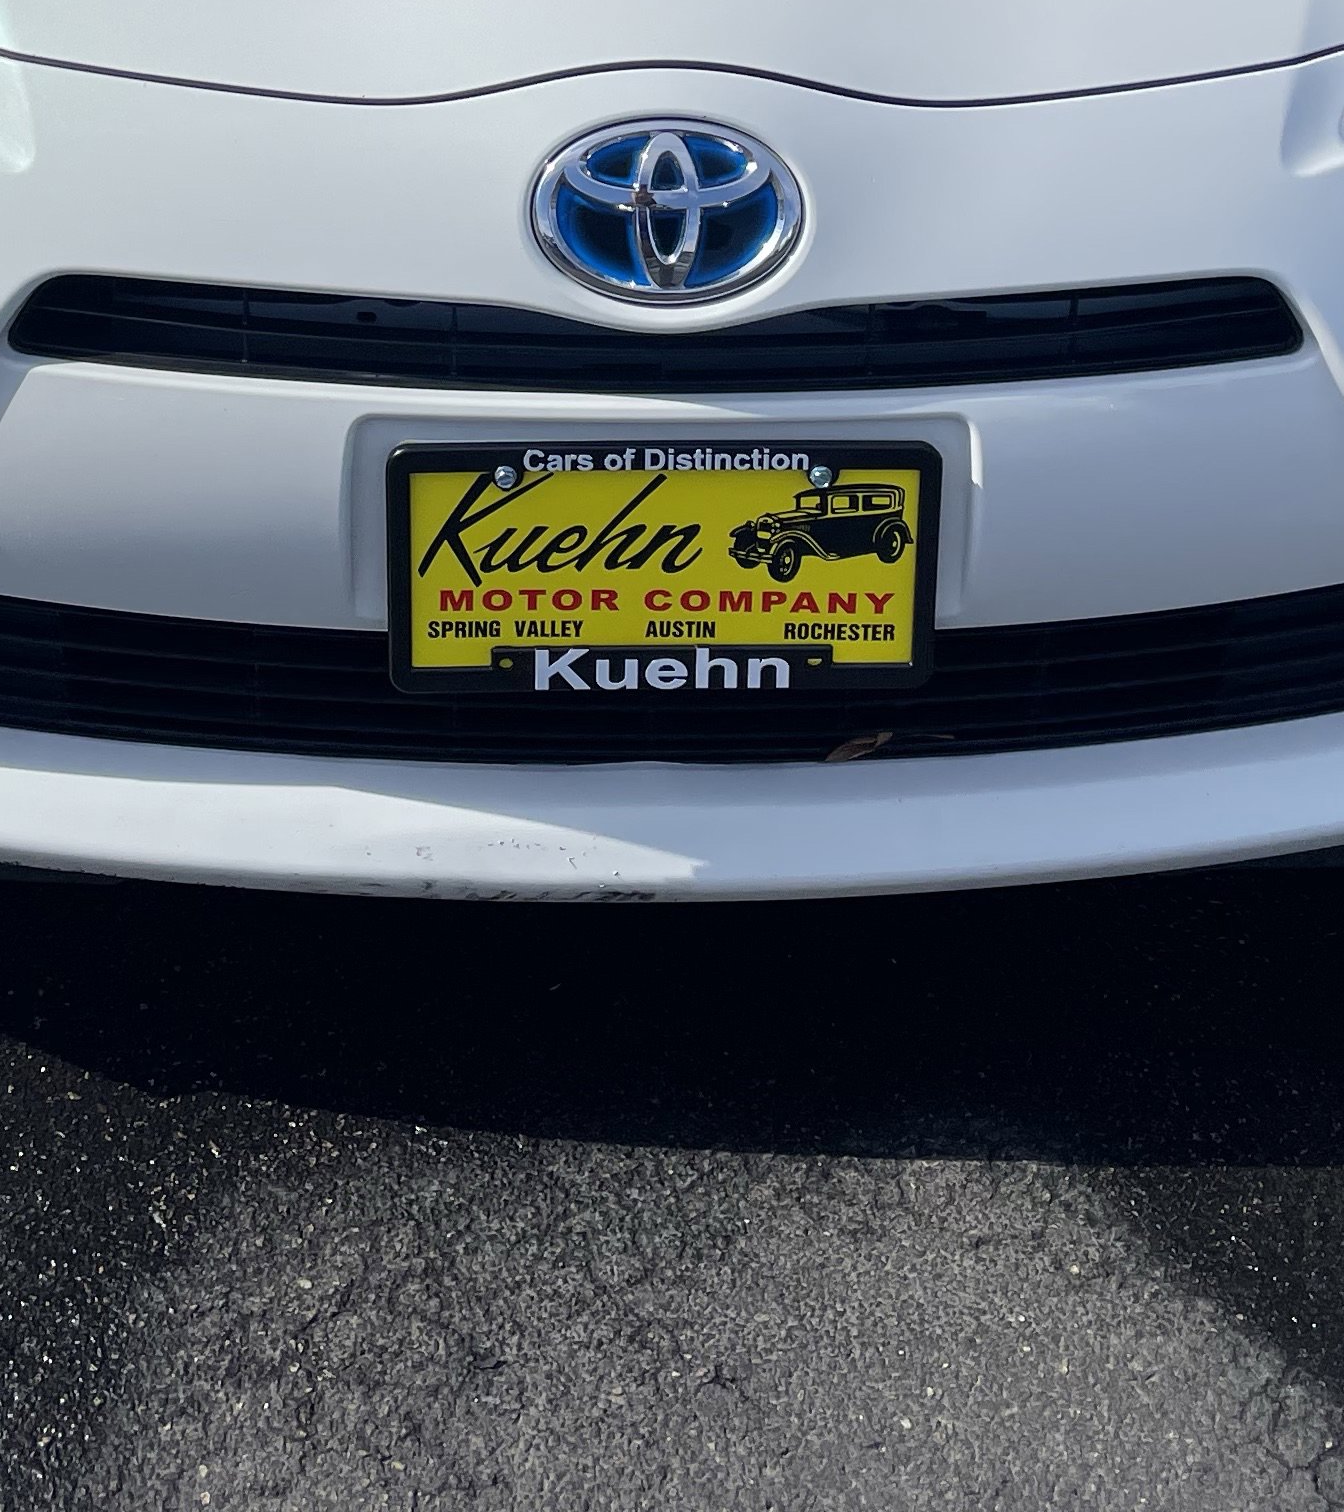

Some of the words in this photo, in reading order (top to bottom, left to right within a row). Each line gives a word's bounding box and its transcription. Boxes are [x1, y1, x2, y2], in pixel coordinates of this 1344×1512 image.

[523, 449, 594, 472] Cars
[604, 448, 636, 472] of
[643, 447, 810, 472] Distinction
[417, 472, 704, 588] Kuehn
[439, 589, 620, 612] MOTOR
[643, 589, 896, 615] COMPANY
[427, 620, 502, 639] SPRING
[514, 620, 585, 639] VALLEY
[645, 620, 717, 639] AUSTIN
[783, 622, 897, 641] ROCHESTER
[534, 647, 791, 691] Kuehn
